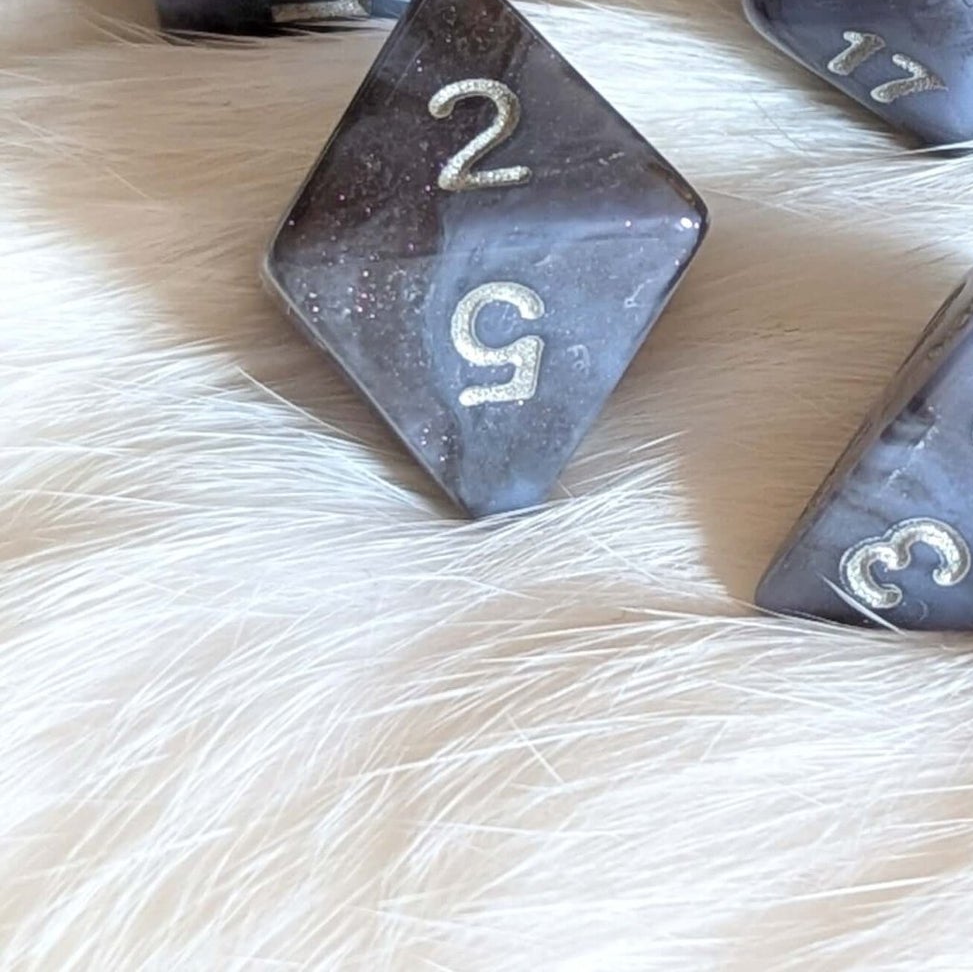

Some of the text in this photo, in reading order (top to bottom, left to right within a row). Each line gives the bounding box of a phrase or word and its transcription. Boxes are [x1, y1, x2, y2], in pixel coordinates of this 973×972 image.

[828, 31, 948, 103] 17
[428, 78, 531, 191] 2
[451, 281, 544, 407] 5
[840, 517, 971, 609] 3
